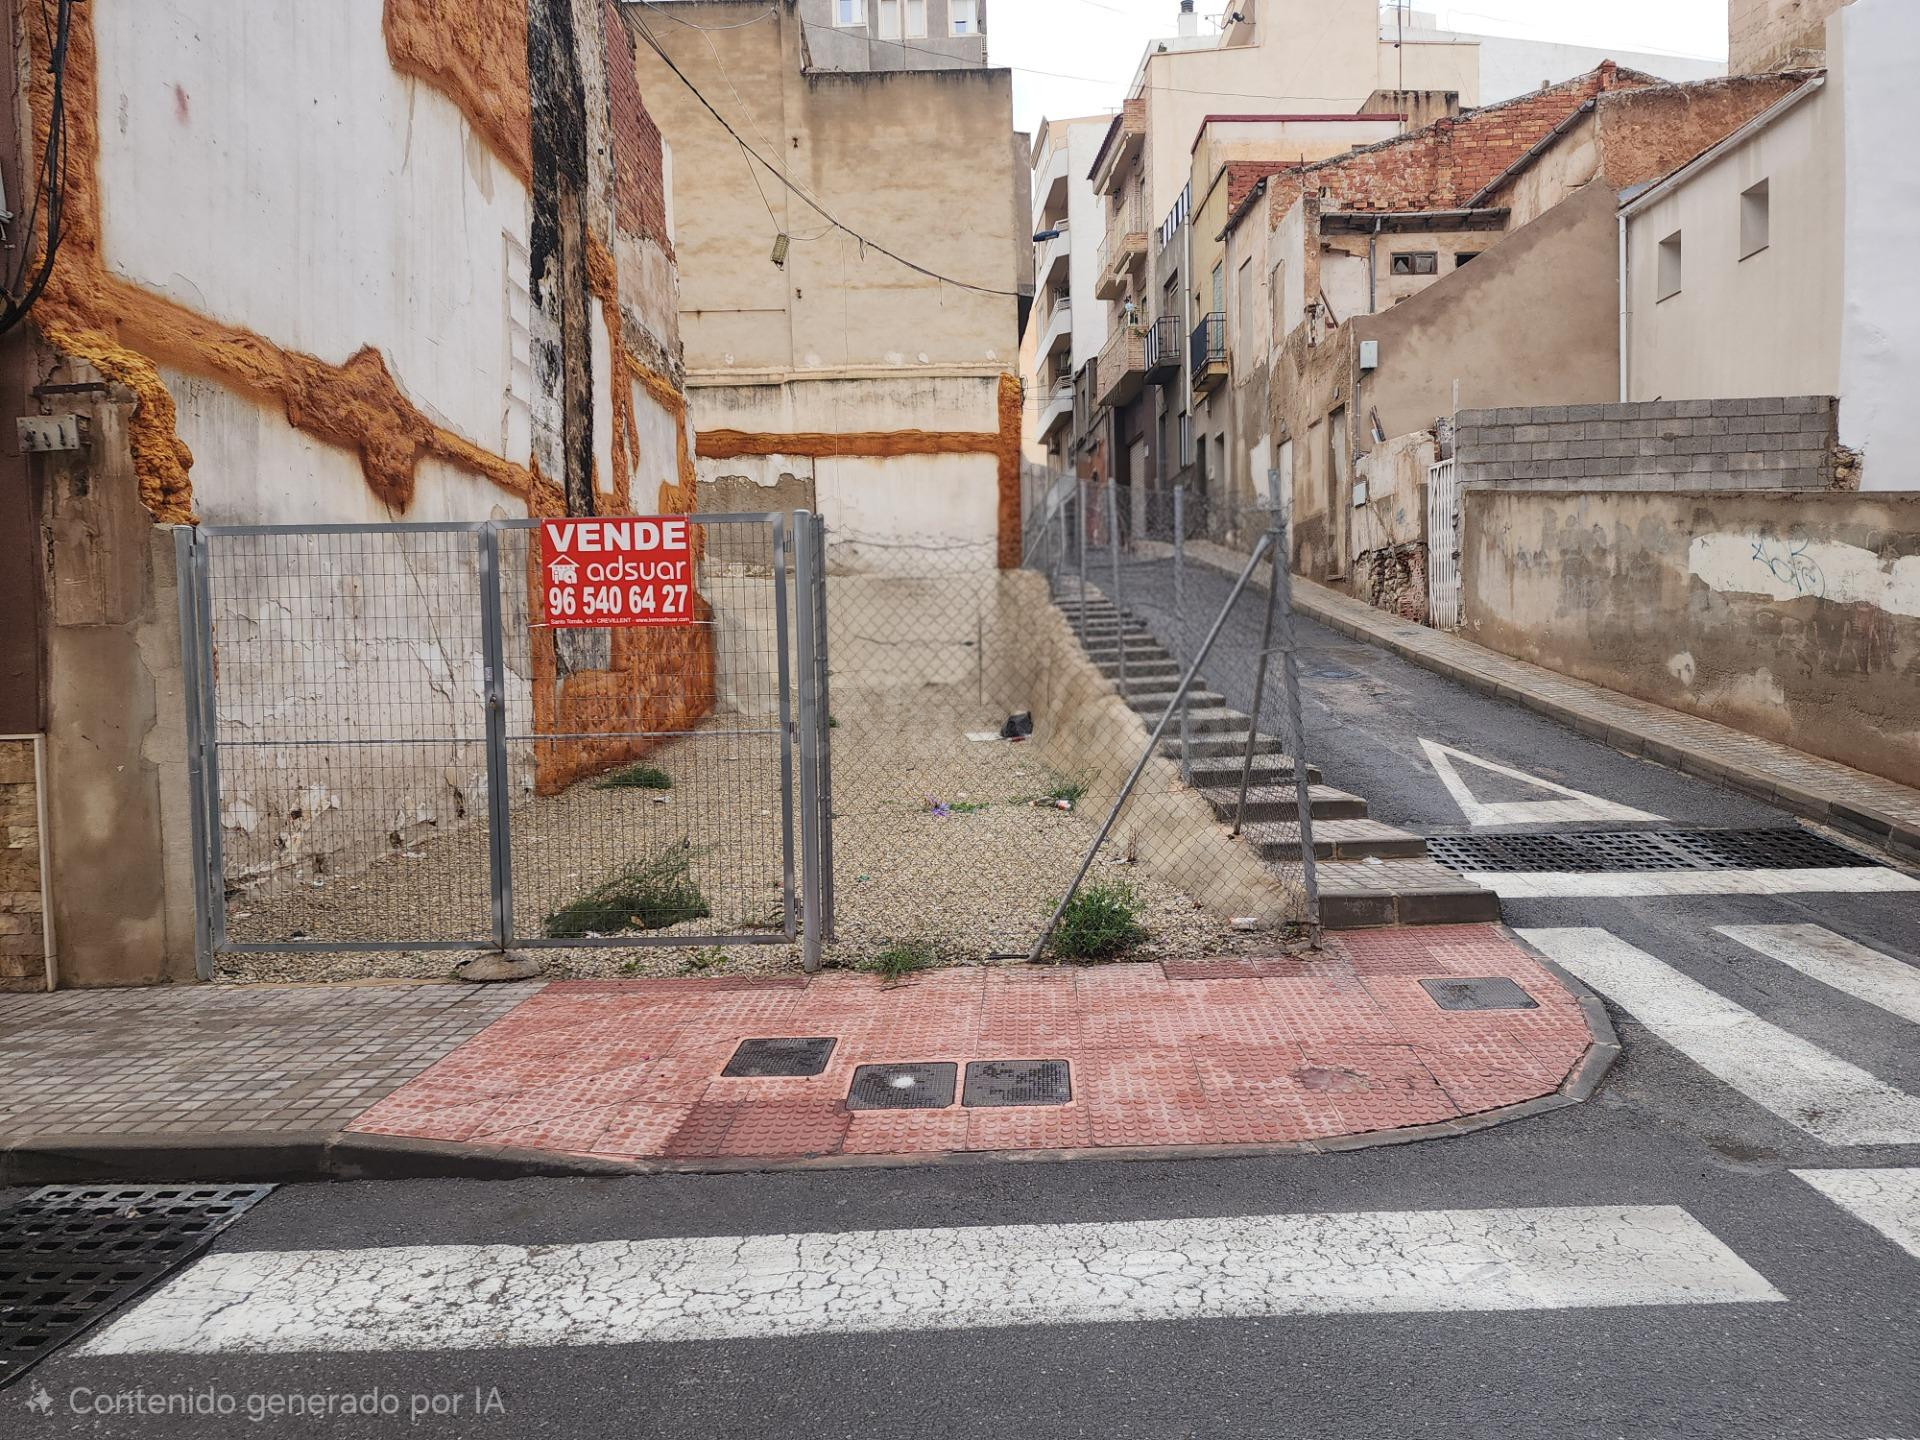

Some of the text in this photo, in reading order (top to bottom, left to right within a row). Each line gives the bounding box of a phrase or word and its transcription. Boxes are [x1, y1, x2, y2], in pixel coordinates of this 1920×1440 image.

[546, 521, 687, 552] VENDE
[586, 555, 687, 582] adsuar
[549, 584, 689, 615] 96 540 64 27
